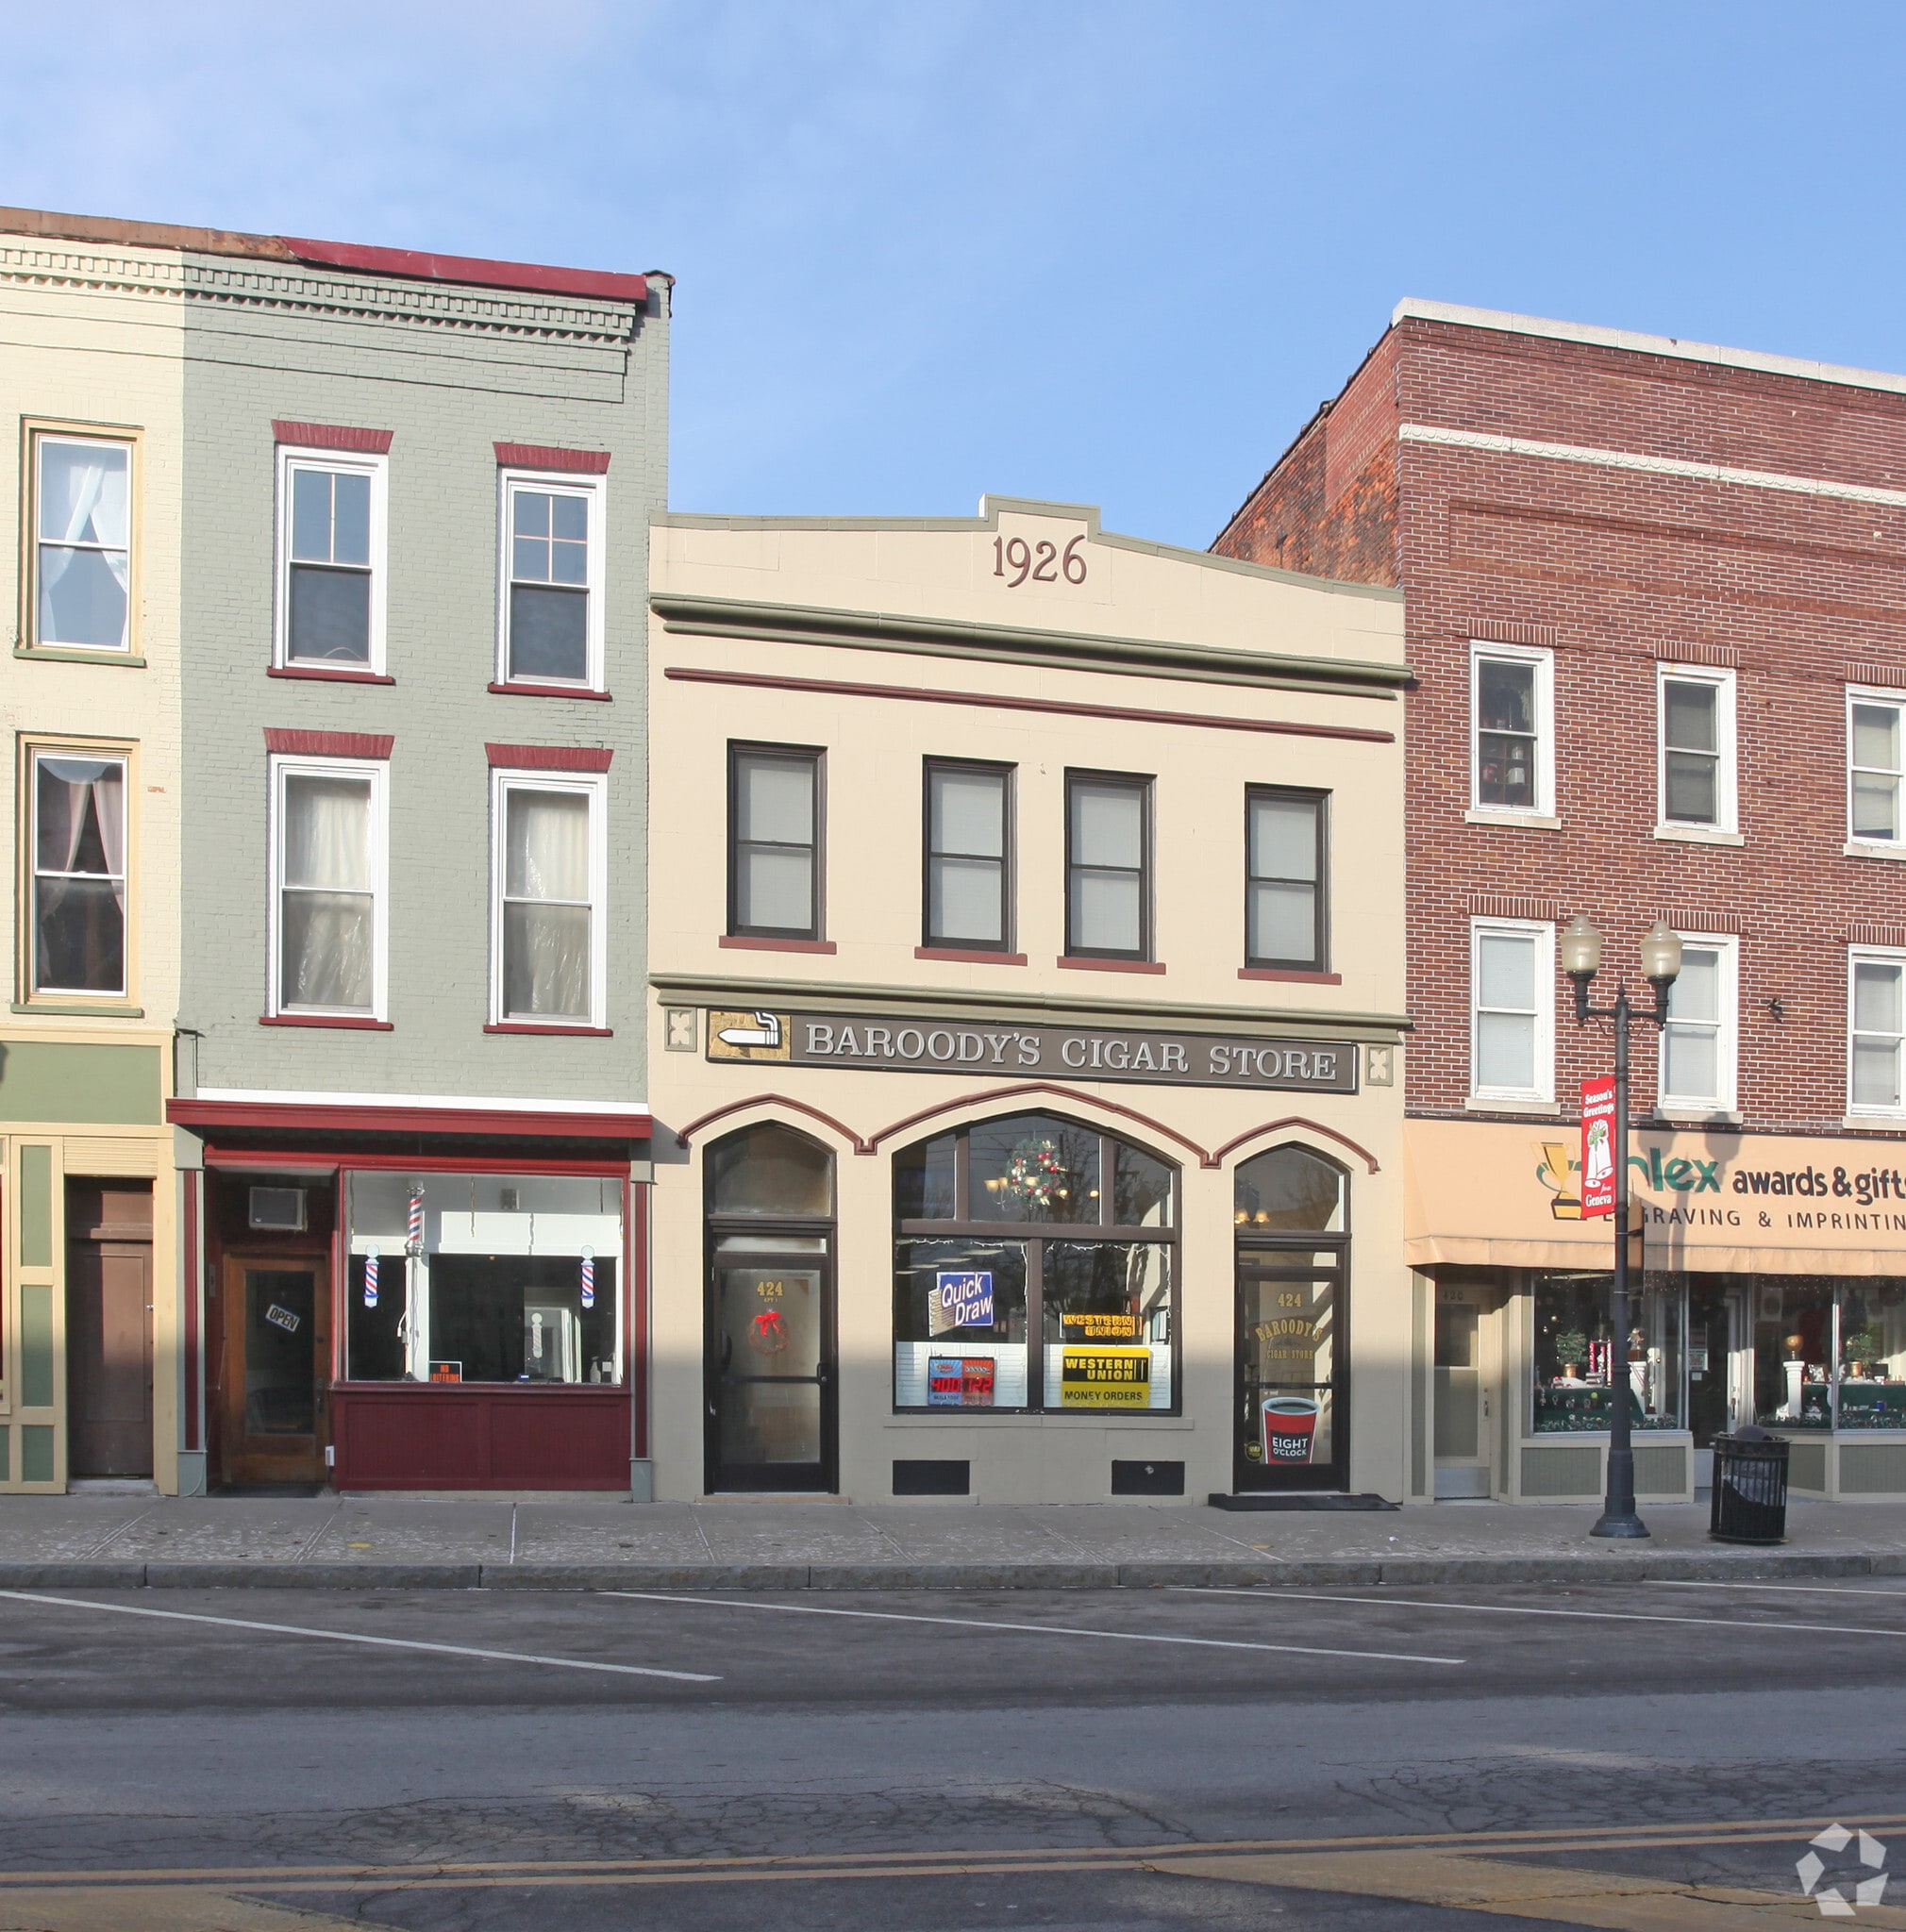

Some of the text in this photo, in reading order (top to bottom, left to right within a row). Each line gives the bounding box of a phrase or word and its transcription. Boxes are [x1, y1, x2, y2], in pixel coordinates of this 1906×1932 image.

[994, 535, 1087, 588] 1926
[806, 1024, 1338, 1081] BAROODY'S CIGAR STORE
[1585, 1089, 1613, 1105] Season's
[1583, 1102, 1614, 1118] Greetings
[1732, 1165, 1829, 1197] awards
[1585, 1193, 1612, 1208] Geneva
[1758, 1210, 1772, 1227] &
[757, 1281, 784, 1297] 424
[942, 1274, 983, 1308] Quick
[1278, 1293, 1302, 1307] 424
[270, 1307, 298, 1329] OPEN
[954, 1294, 993, 1327] Draw
[1062, 1314, 1132, 1326] WESTERN
[1084, 1325, 1132, 1337] UNION
[1255, 1318, 1324, 1342] BAROODY'S
[1266, 1349, 1314, 1359] CIGAR STORE
[1065, 1358, 1133, 1370] WESTERN
[1086, 1369, 1133, 1381] UNION
[1064, 1391, 1144, 1401] MONEY ORDERS
[1272, 1437, 1309, 1449] EIGHT
[1273, 1447, 1307, 1457] O'CLOCK
